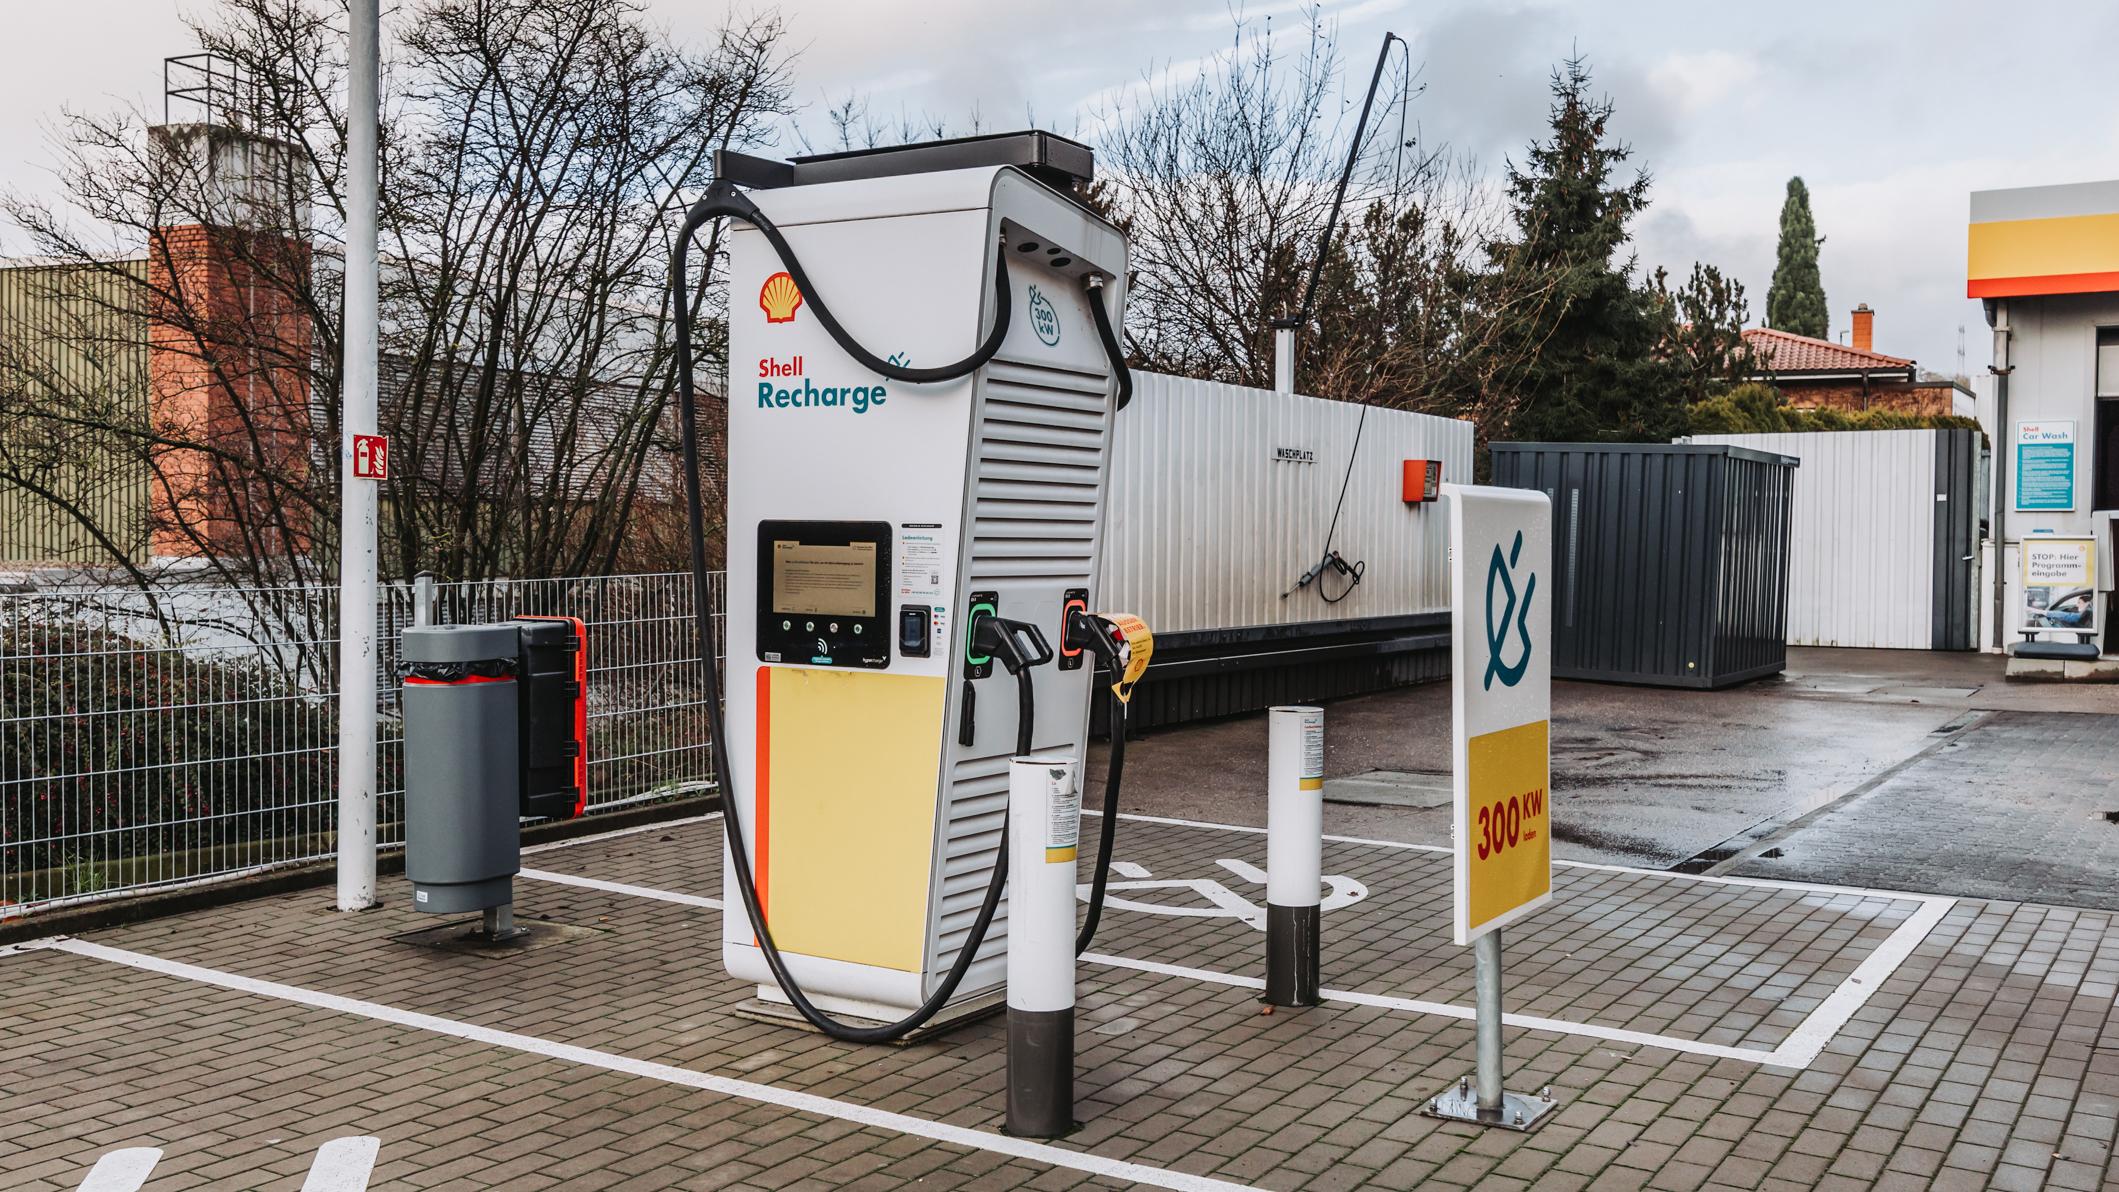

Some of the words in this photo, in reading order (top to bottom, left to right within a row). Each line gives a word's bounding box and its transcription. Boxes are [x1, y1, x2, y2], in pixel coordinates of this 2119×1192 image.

[1035, 308, 1052, 323] 300
[1038, 321, 1053, 335] kW
[759, 356, 802, 377] Shell
[758, 378, 886, 414] Recharge
[2023, 432, 2038, 440] Car
[2042, 432, 2068, 440] Wash
[1276, 447, 1313, 460] WASCHPLATZ
[2060, 553, 2079, 561] Hier
[2032, 570, 2067, 578] eingabe
[1478, 795, 1520, 861] 300
[1523, 788, 1543, 820] KW
